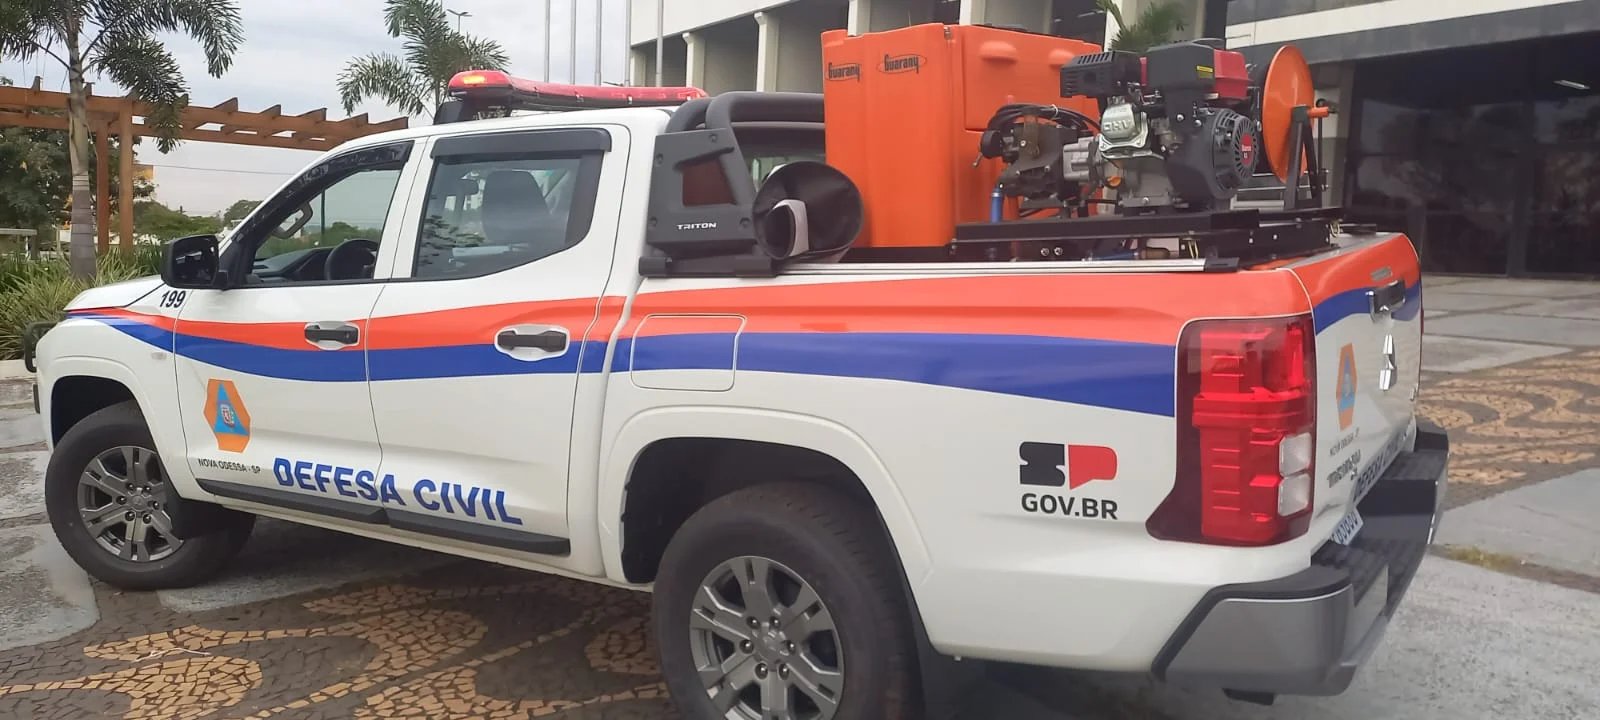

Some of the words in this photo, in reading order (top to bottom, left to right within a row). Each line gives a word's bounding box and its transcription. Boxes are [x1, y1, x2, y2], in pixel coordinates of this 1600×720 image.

[884, 54, 919, 74] Guarany
[676, 222, 717, 230] TRITON
[160, 290, 186, 308] 199
[198, 458, 218, 469] NOVA
[218, 461, 248, 473] ODESSA
[252, 465, 261, 474] SP
[273, 457, 406, 506] DEFESA
[413, 478, 523, 526] CIVIL
[1021, 492, 1118, 520] GOV.BR
